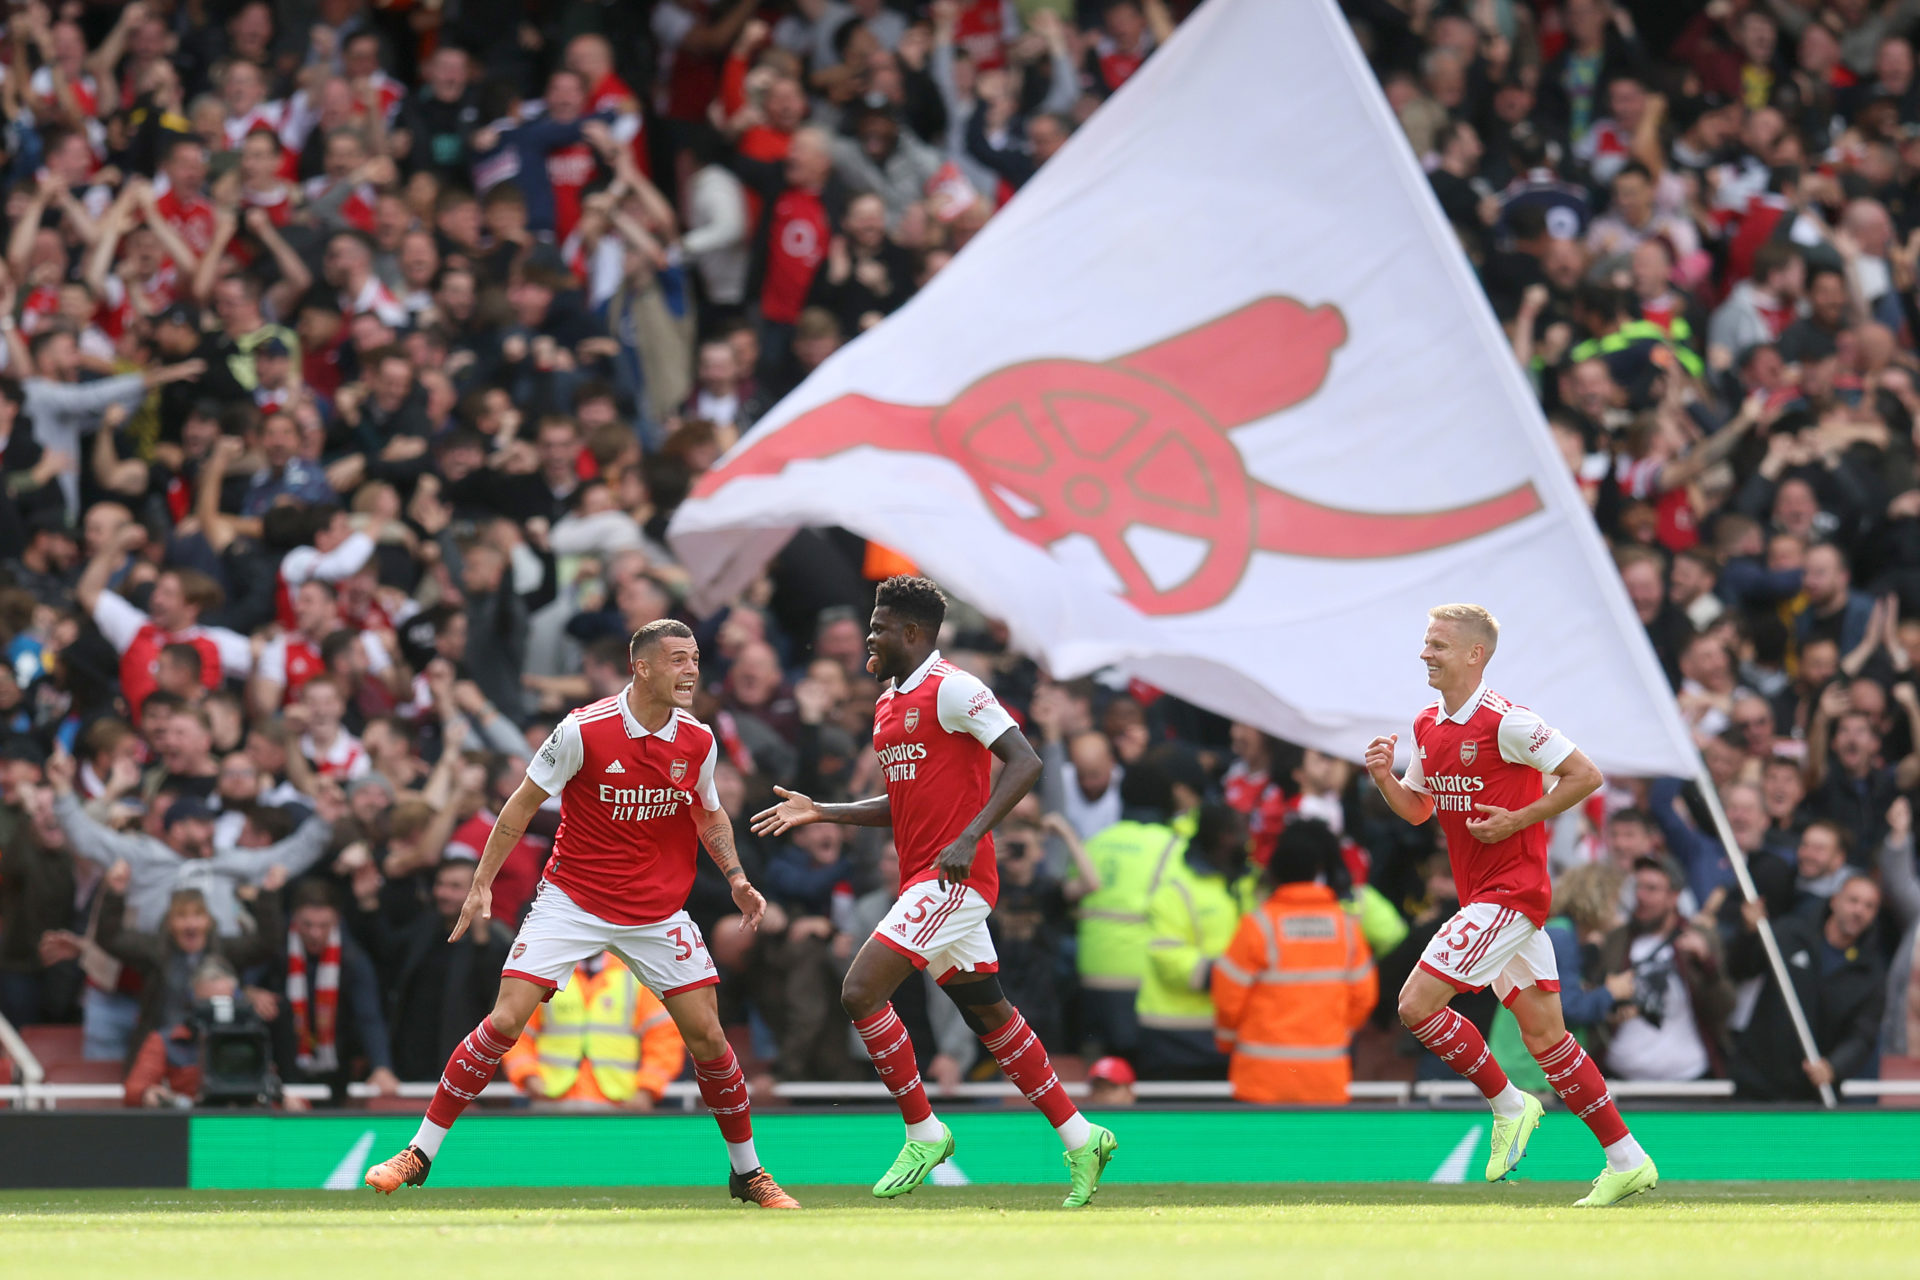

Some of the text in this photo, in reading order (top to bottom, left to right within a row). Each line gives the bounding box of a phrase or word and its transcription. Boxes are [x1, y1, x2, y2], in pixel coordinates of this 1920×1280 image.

[968, 690, 987, 704] VISIT
[877, 741, 927, 768] mirates
[1424, 771, 1484, 793] mirates
[598, 784, 693, 806] Emirates
[612, 802, 679, 822] FLY BETTER
[904, 895, 936, 924] 5
[1440, 1041, 1468, 1062] AFC
[456, 1059, 488, 1079] AFC
